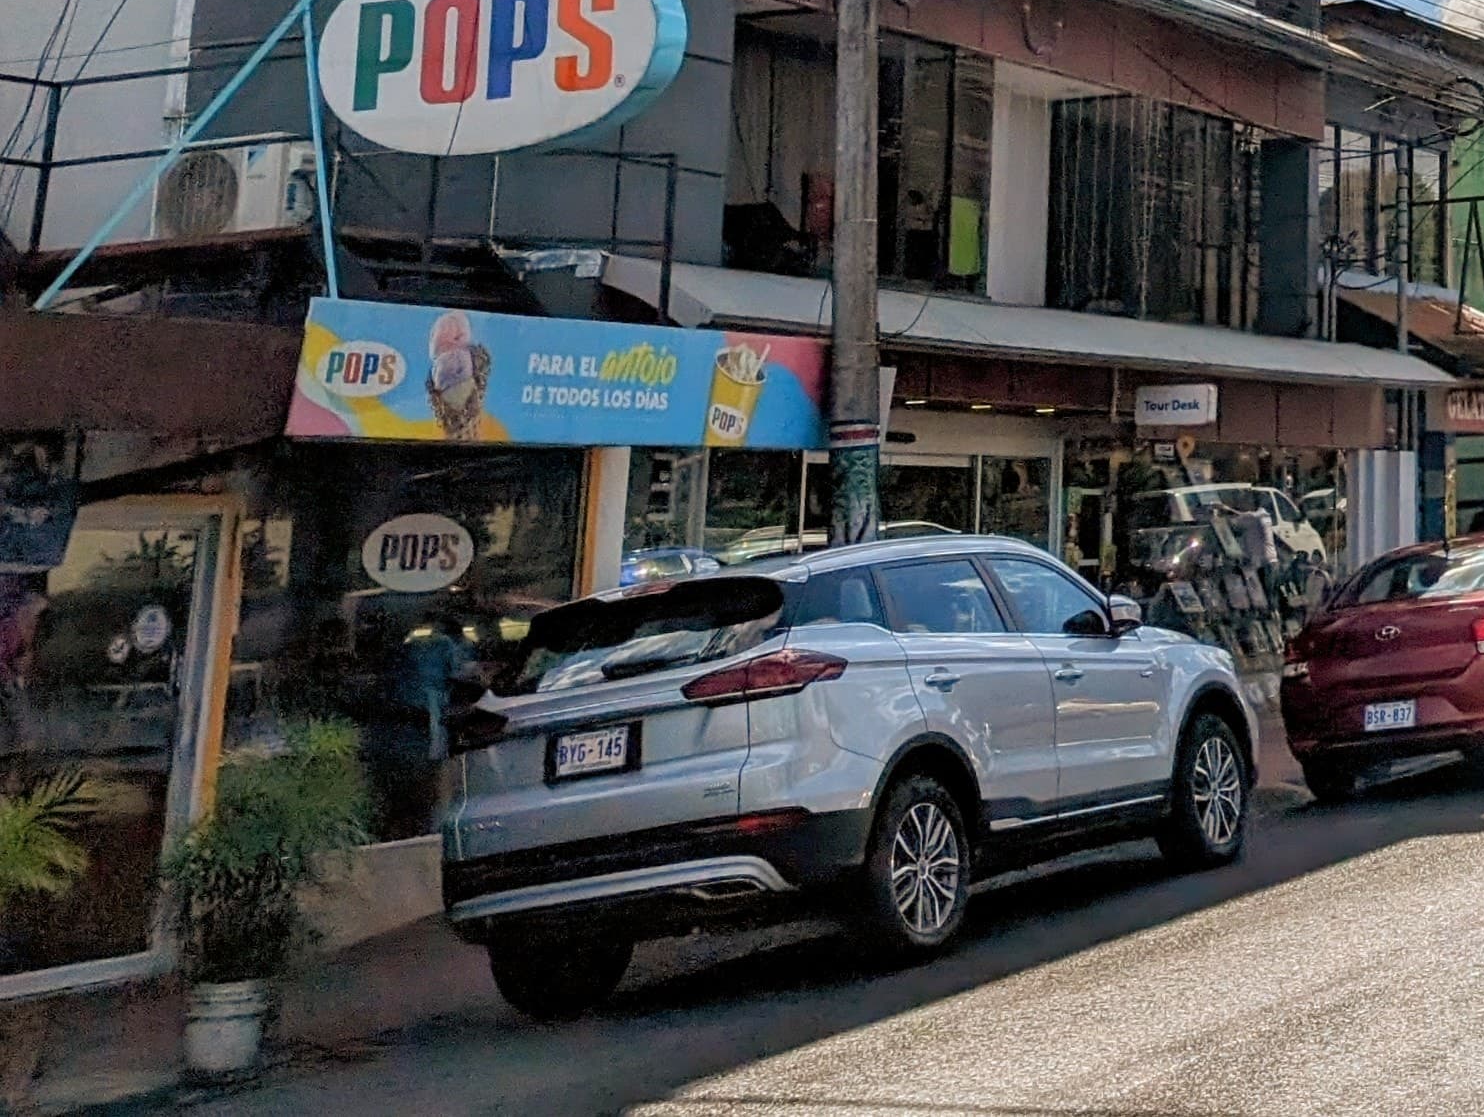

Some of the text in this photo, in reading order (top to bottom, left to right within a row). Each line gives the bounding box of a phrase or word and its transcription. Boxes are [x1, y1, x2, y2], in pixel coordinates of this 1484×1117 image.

[325, 351, 397, 384] POPS
[528, 353, 574, 376] PARA
[580, 356, 599, 378] EL
[522, 385, 669, 410] DE TODOS LOS DÍAS
[1144, 399, 1200, 411] Tour Desk
[378, 533, 460, 572] POPS
[1367, 706, 1412, 724] BSR-837
[559, 736, 622, 766] BYG-145
